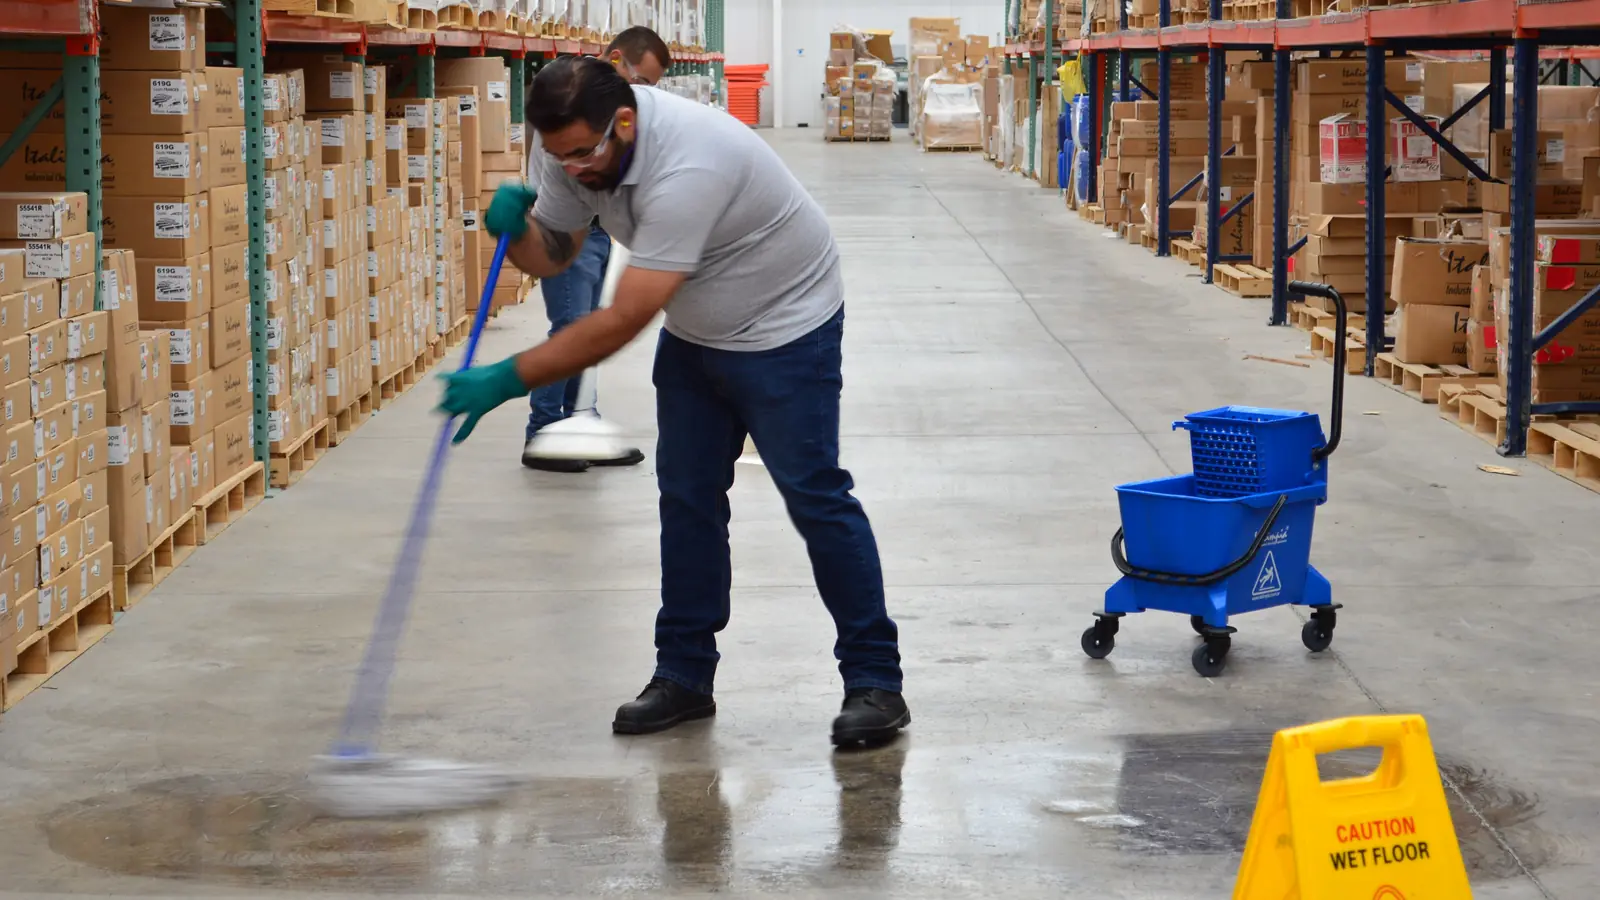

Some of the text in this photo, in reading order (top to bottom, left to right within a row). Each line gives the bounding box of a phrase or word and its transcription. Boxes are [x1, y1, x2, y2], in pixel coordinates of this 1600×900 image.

[1336, 816, 1416, 843] CAUTION
[1330, 842, 1430, 870] WET FLOOR
